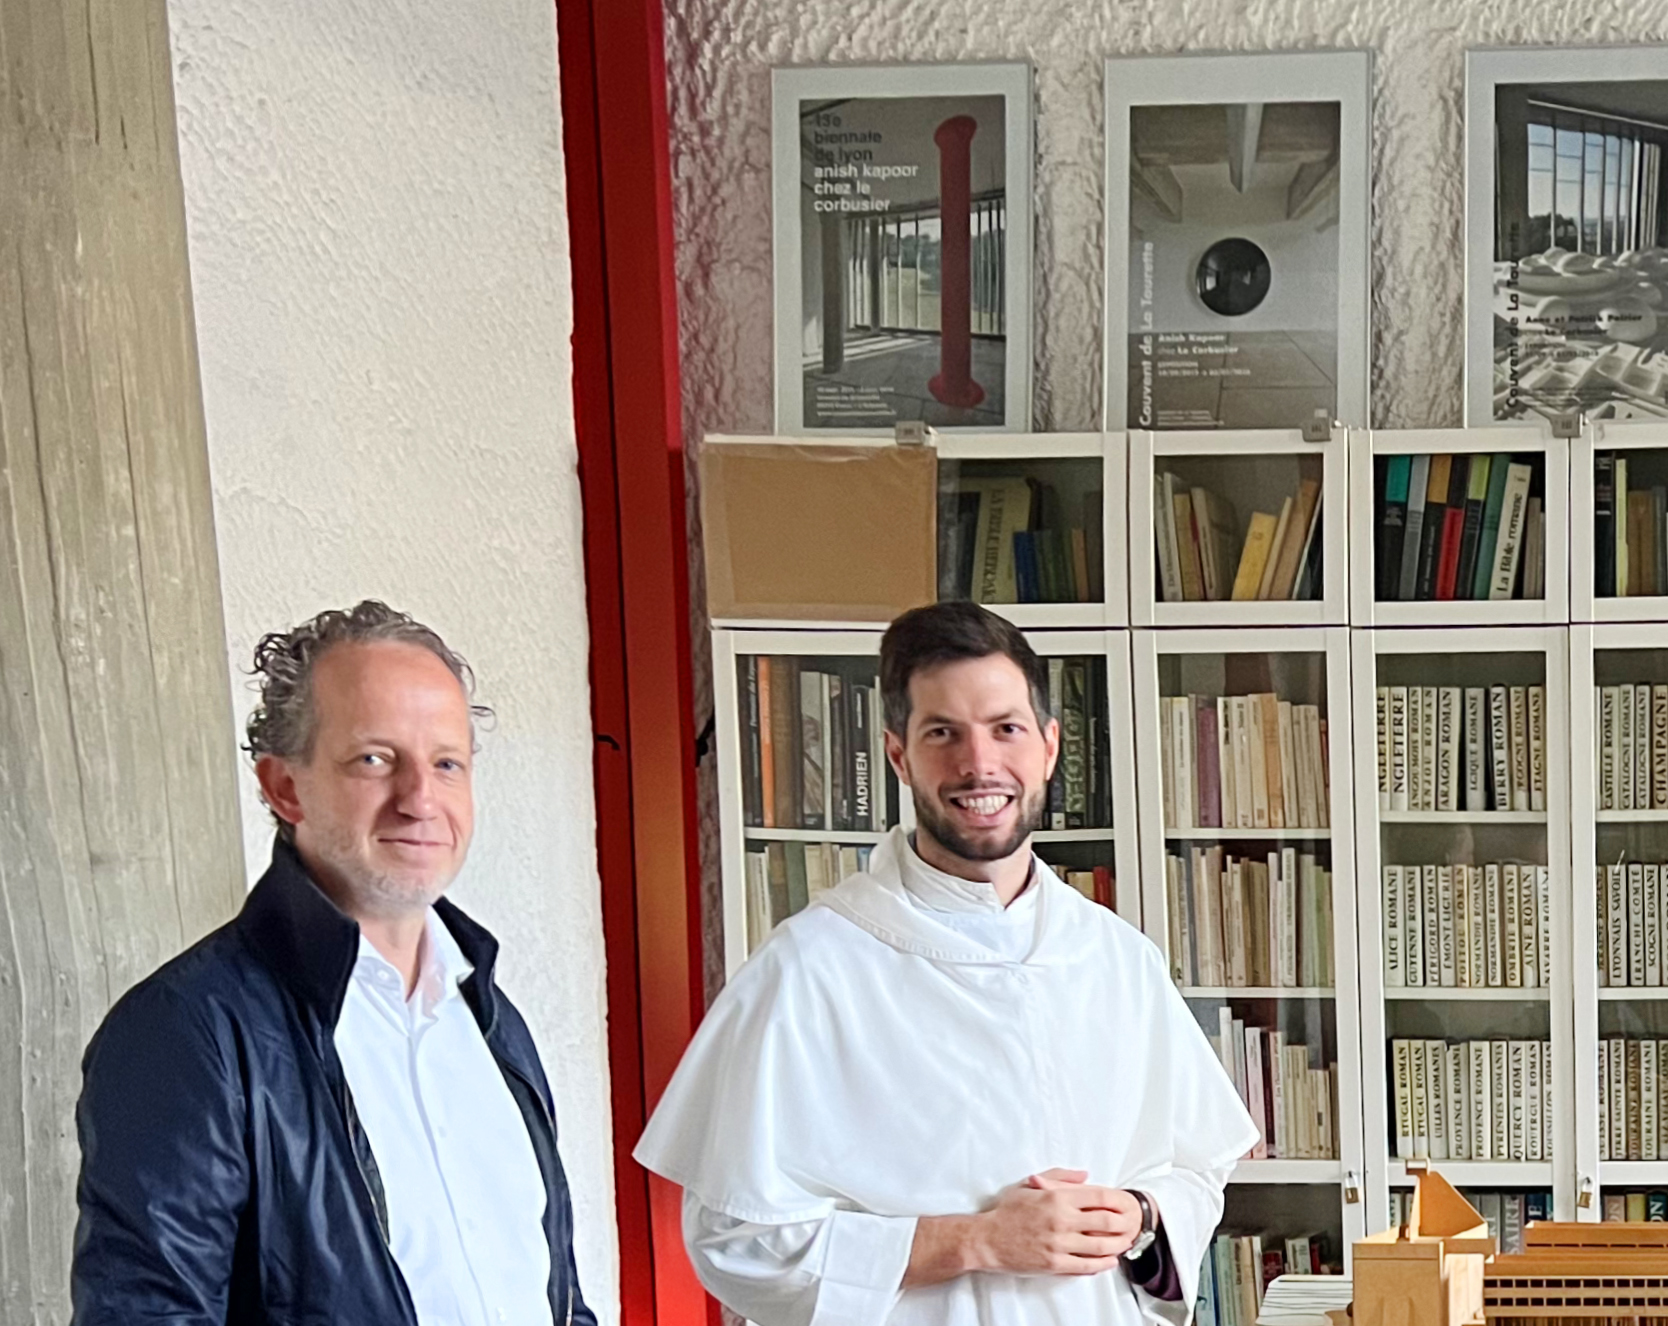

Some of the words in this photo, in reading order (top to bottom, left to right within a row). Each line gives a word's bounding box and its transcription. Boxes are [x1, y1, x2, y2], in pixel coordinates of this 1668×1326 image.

[814, 130, 882, 143] biennale
[814, 146, 834, 160] de
[838, 146, 873, 163] lyon
[813, 180, 851, 195] chez
[856, 180, 871, 194] le
[814, 163, 858, 178] anish
[862, 163, 919, 181] kapoor
[813, 197, 890, 212] corbusier
[1140, 242, 1154, 307] Tourette
[1140, 312, 1153, 330] La
[1506, 316, 1519, 337] de
[1507, 293, 1519, 311] La
[1139, 334, 1152, 355] de
[1139, 360, 1152, 427] Couvent
[1506, 342, 1519, 408] Couvent
[1508, 492, 1523, 539] romane
[1500, 542, 1516, 573] Bible
[1496, 576, 1510, 592] La
[1410, 689, 1419, 734] ROMAN
[1424, 689, 1433, 747] ROMAN
[1441, 690, 1452, 744] ROMAN
[1469, 696, 1478, 744] ROMANE
[1492, 692, 1505, 751] ROMAN
[1531, 692, 1541, 741] ROMANE
[1604, 691, 1613, 748] ROMANE
[1622, 689, 1631, 738] ROMANE
[1638, 691, 1647, 739] ROMANE
[1392, 692, 1405, 794] NGLETERRE
[1655, 691, 1667, 806] CHAMPAGNE
[856, 751, 869, 817] HADRIEN
[1423, 757, 1433, 809] ANJOU
[1440, 748, 1451, 808] ARAGON
[1495, 760, 1507, 808] BERRY
[1604, 752, 1614, 810] CASTILLE
[1622, 743, 1631, 809] CATALOGNE
[1638, 743, 1647, 809] CATALOGNE
[1387, 869, 1398, 929] ROMANE
[1407, 870, 1416, 922] ROMANE
[1427, 868, 1437, 914] ROMAN
[1441, 872, 1452, 922] LIGURIE
[1455, 867, 1466, 921] ROMAN
[1487, 869, 1496, 914] ROMANE
[1506, 870, 1515, 924] ROMANE
[1522, 873, 1534, 927] ROMAN
[1611, 869, 1621, 911] SAVOIE
[1646, 868, 1656, 918] ROMANE
[1408, 926, 1419, 984] GUYENNE
[1457, 930, 1468, 984] POITOU
[1474, 921, 1483, 985] NORMANDIE
[1488, 918, 1498, 983] NORMANDIE
[1508, 930, 1517, 982] OMBRIE
[1612, 917, 1622, 978] LYONNAIS
[1633, 922, 1642, 981] FRANCHE
[1398, 1046, 1408, 1089] ROMAN
[1414, 1046, 1424, 1089] ROMAN
[1431, 1046, 1441, 1100] ROMANES
[1452, 1047, 1462, 1095] ROMANE
[1474, 1047, 1483, 1095] ROMANE
[1495, 1044, 1504, 1098] ROMANES
[1512, 1046, 1523, 1098] ROMAN
[1529, 1044, 1538, 1087] ROMAN
[1613, 1041, 1622, 1085] ROMANE
[1643, 1043, 1652, 1092] ROMANE
[1454, 1100, 1464, 1157] PROVENCE
[1475, 1100, 1484, 1157] PROVENCE
[1513, 1104, 1524, 1160] QUERCY
[1529, 1093, 1539, 1157] ROUERGUE
[1644, 1100, 1654, 1158] TOURAINE
